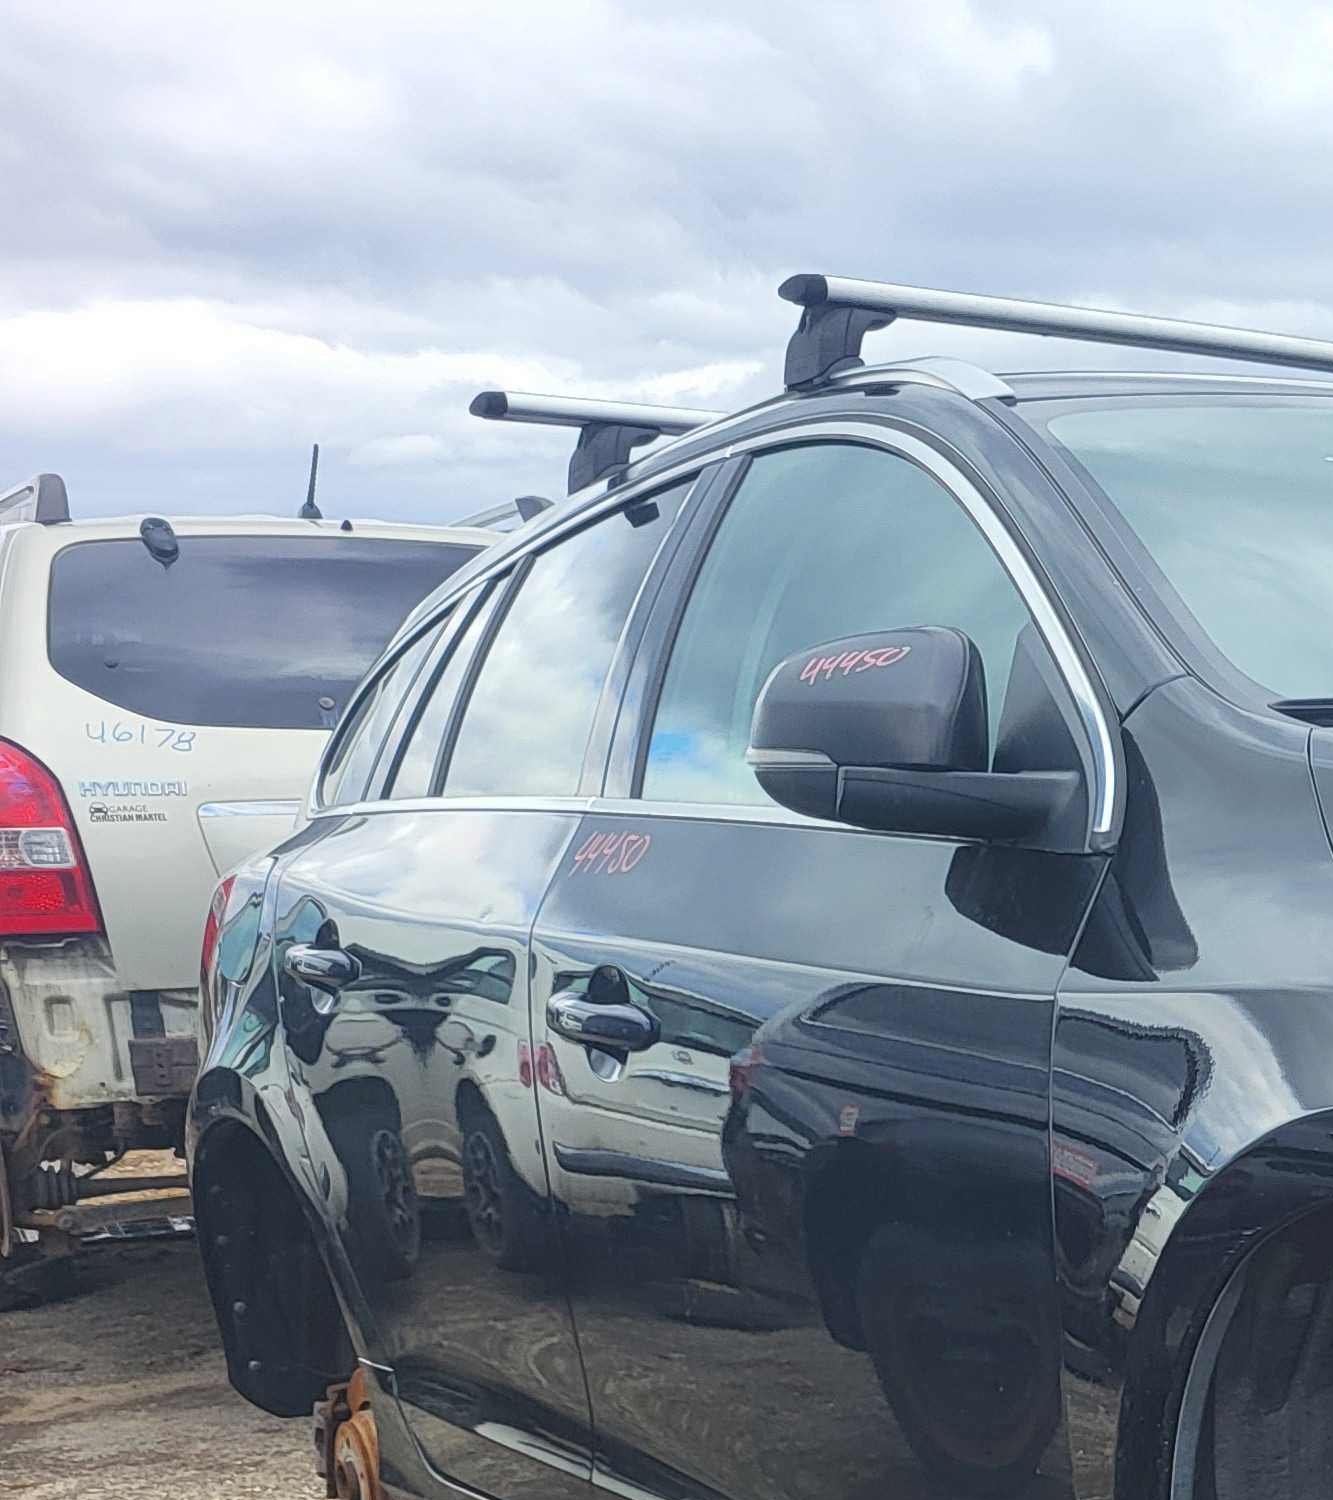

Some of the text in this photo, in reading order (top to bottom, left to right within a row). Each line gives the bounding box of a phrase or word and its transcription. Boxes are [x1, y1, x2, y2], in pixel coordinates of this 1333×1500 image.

[800, 646, 911, 685] 44450
[86, 720, 196, 752] 46178
[79, 781, 188, 797] HYUNDAI
[90, 812, 168, 822] CHRISTIAN MARTEL
[108, 804, 148, 813] GARAGE
[568, 830, 651, 877] 44450
